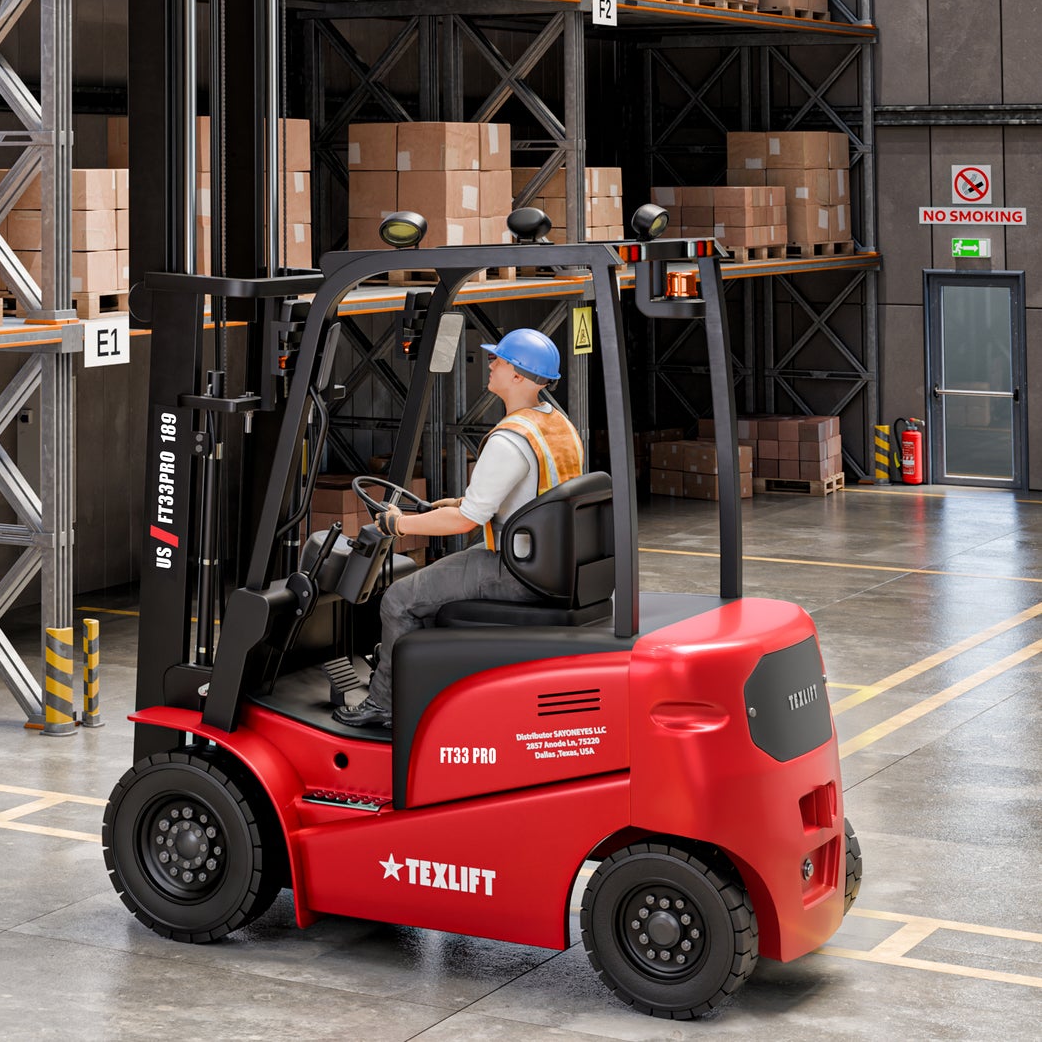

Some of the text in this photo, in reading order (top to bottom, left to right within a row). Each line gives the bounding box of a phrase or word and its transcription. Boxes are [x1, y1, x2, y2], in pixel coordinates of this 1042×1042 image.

[923, 210, 1023, 223] NO SMOKING
[97, 327, 121, 357] E1
[155, 412, 177, 570] US FT33PRO 189
[788, 683, 818, 711] TEXLIFT
[516, 726, 607, 741] Distributor SAYONEYES LLC
[526, 741, 543, 750] 2857
[544, 740, 566, 749] Anode
[578, 737, 600, 746] 75220
[440, 747, 497, 764] FT33 PRO
[534, 750, 556, 759] Dallas
[579, 747, 595, 756] USA
[405, 857, 496, 896] TEXLIFT
